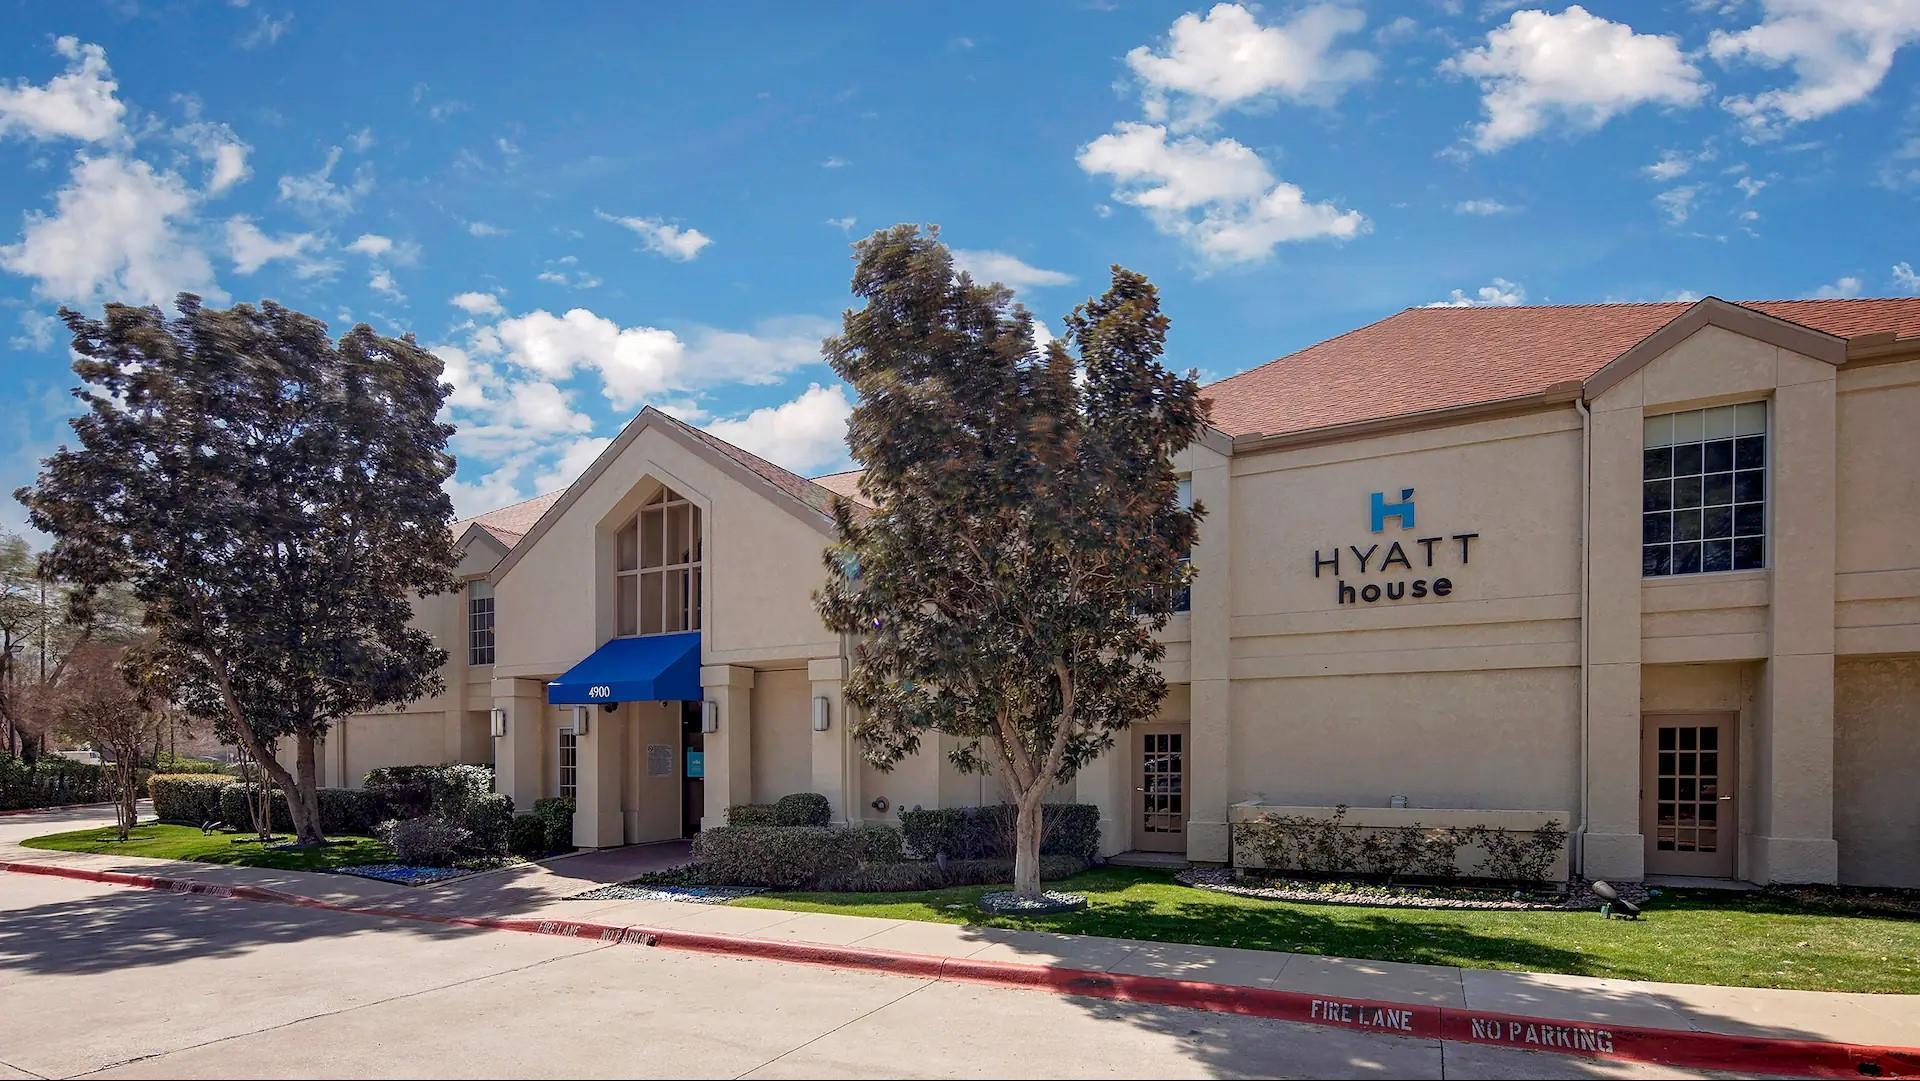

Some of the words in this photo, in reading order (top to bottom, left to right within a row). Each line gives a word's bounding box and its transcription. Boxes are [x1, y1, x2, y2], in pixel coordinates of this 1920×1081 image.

[1315, 533, 1479, 578] HYATT
[1338, 577, 1453, 604] house
[588, 686, 611, 698] 4900
[537, 921, 555, 935] FIRE
[556, 923, 581, 938] LANE
[599, 928, 615, 942] NO
[1310, 999, 1352, 1023] FIRE
[1359, 1005, 1413, 1031] LANE
[1471, 1017, 1501, 1040] NO
[1509, 1021, 1614, 1054] PARKING
